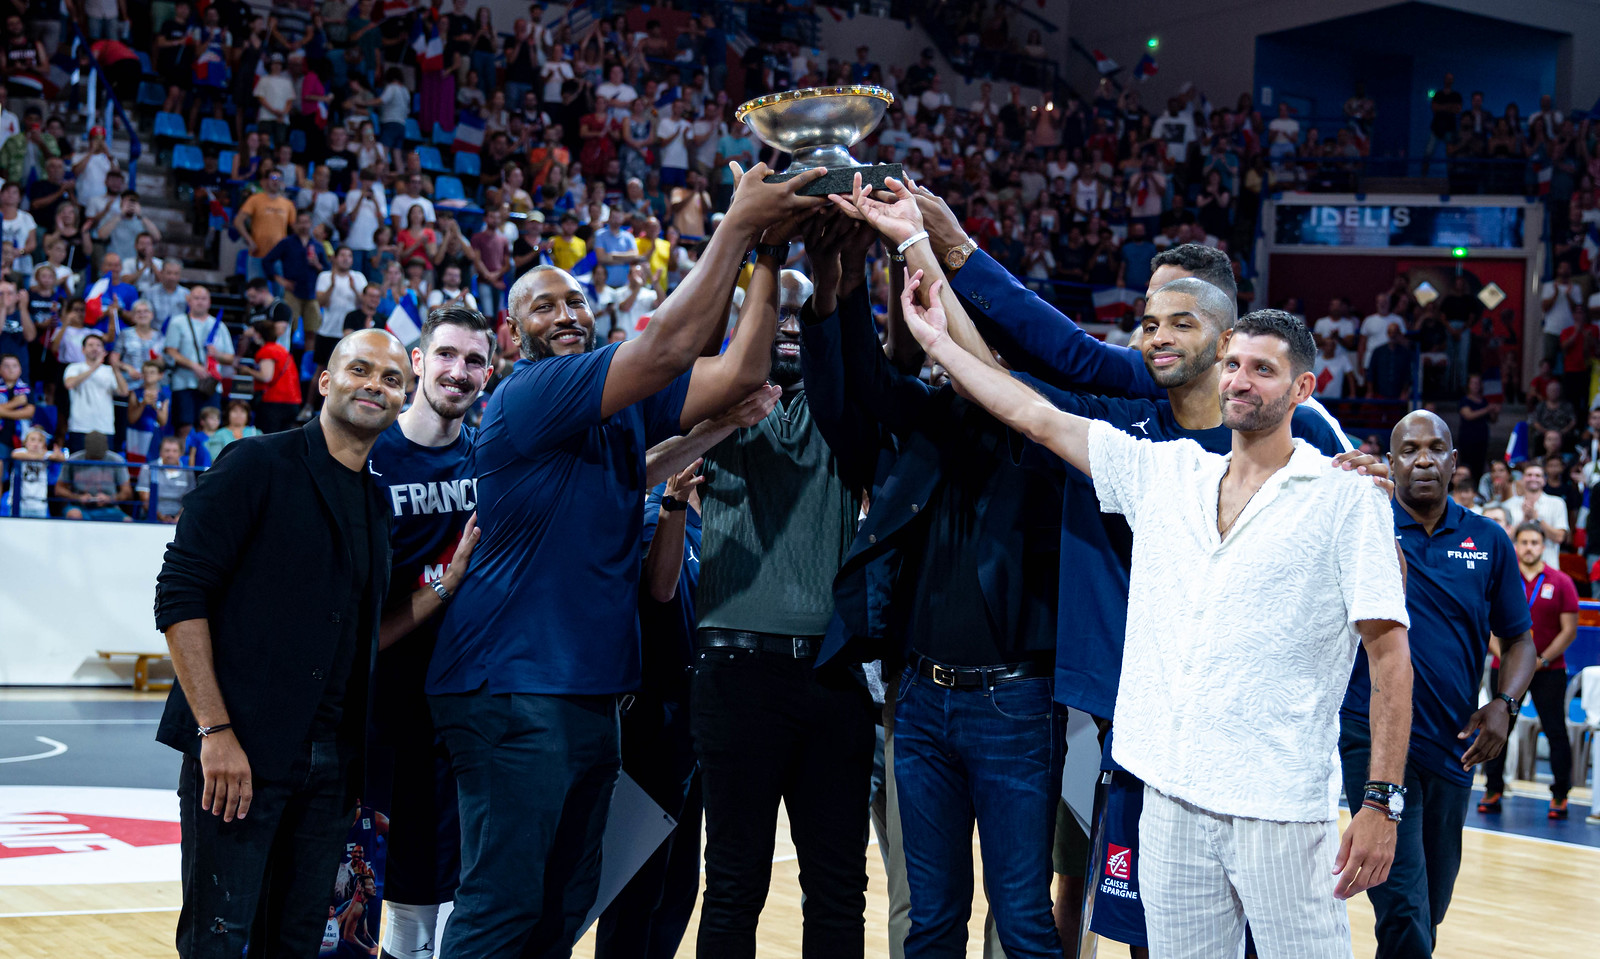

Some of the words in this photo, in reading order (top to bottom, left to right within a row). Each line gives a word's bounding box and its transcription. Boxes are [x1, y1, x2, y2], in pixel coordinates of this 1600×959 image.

[1310, 206, 1411, 228] IDELIS
[1447, 550, 1489, 560] FRANCE
[1104, 878, 1129, 890] CAISSE
